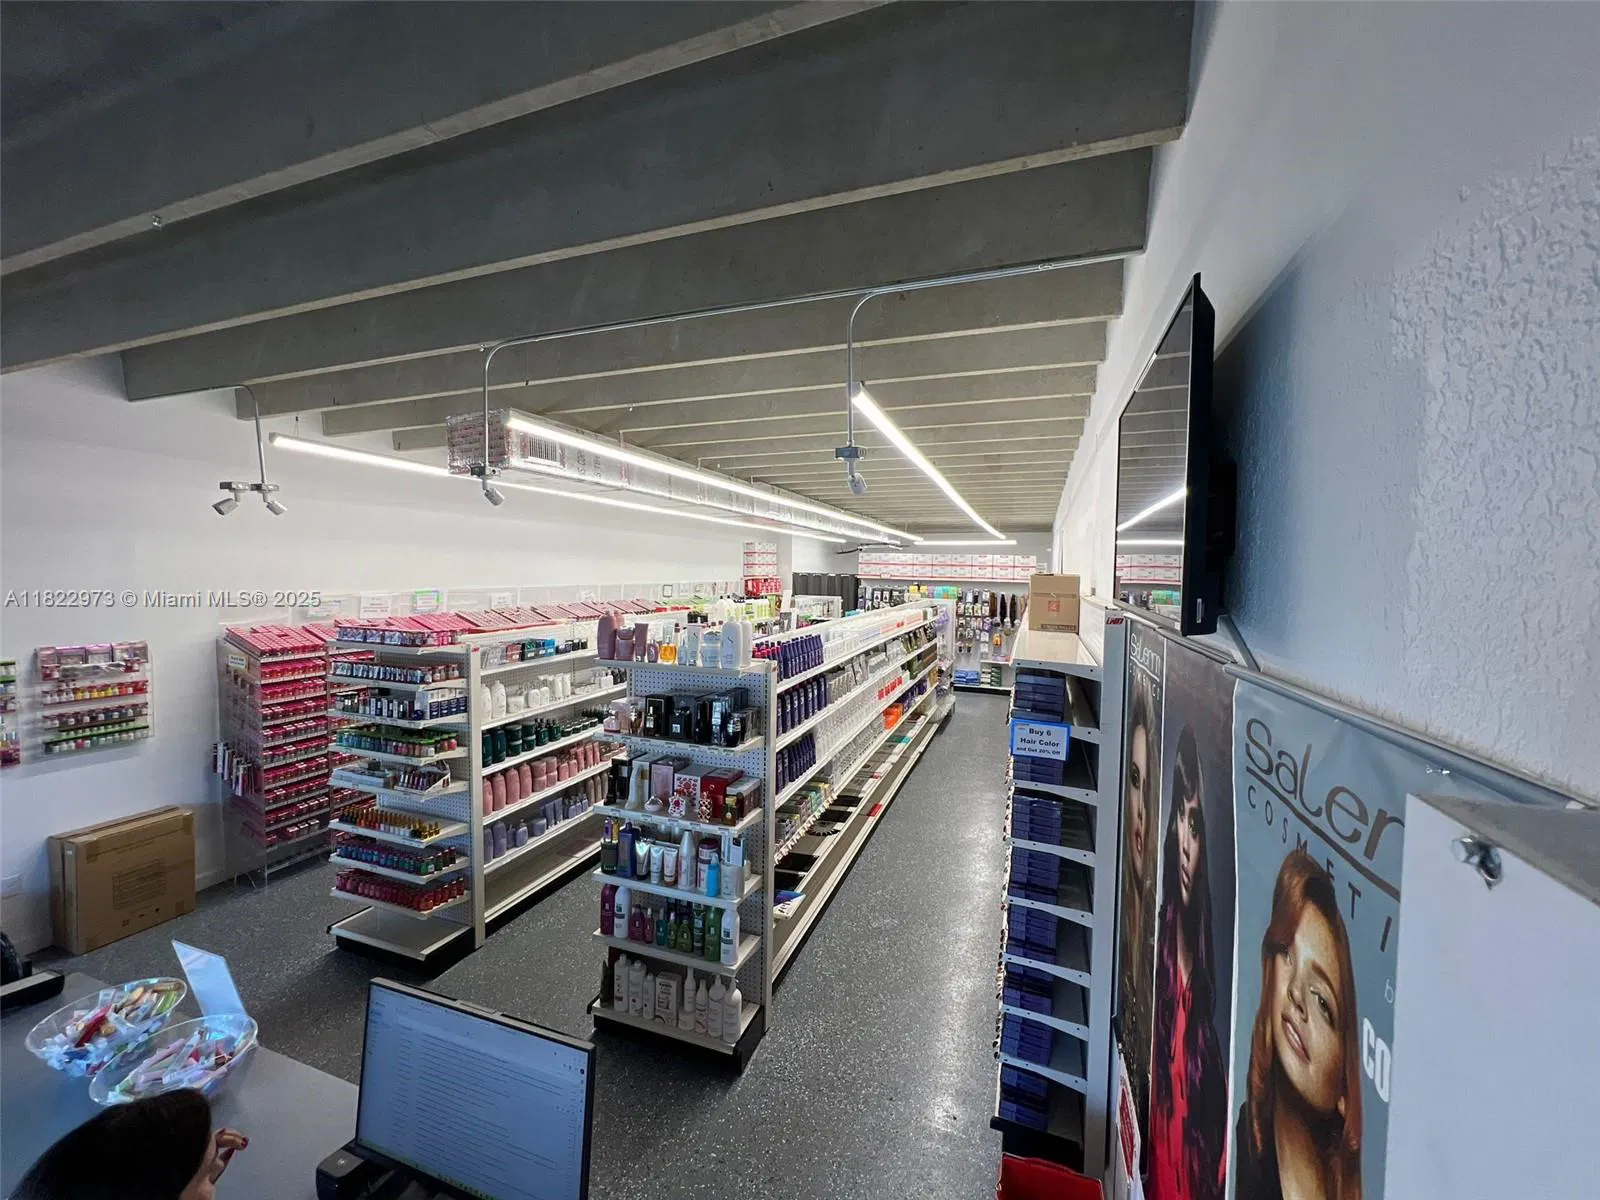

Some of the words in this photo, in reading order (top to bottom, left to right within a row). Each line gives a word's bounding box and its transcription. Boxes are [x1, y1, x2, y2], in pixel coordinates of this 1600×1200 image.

[1029, 728, 1044, 736] Buy
[1020, 737, 1036, 745] Hair
[1038, 739, 1060, 747] Color
